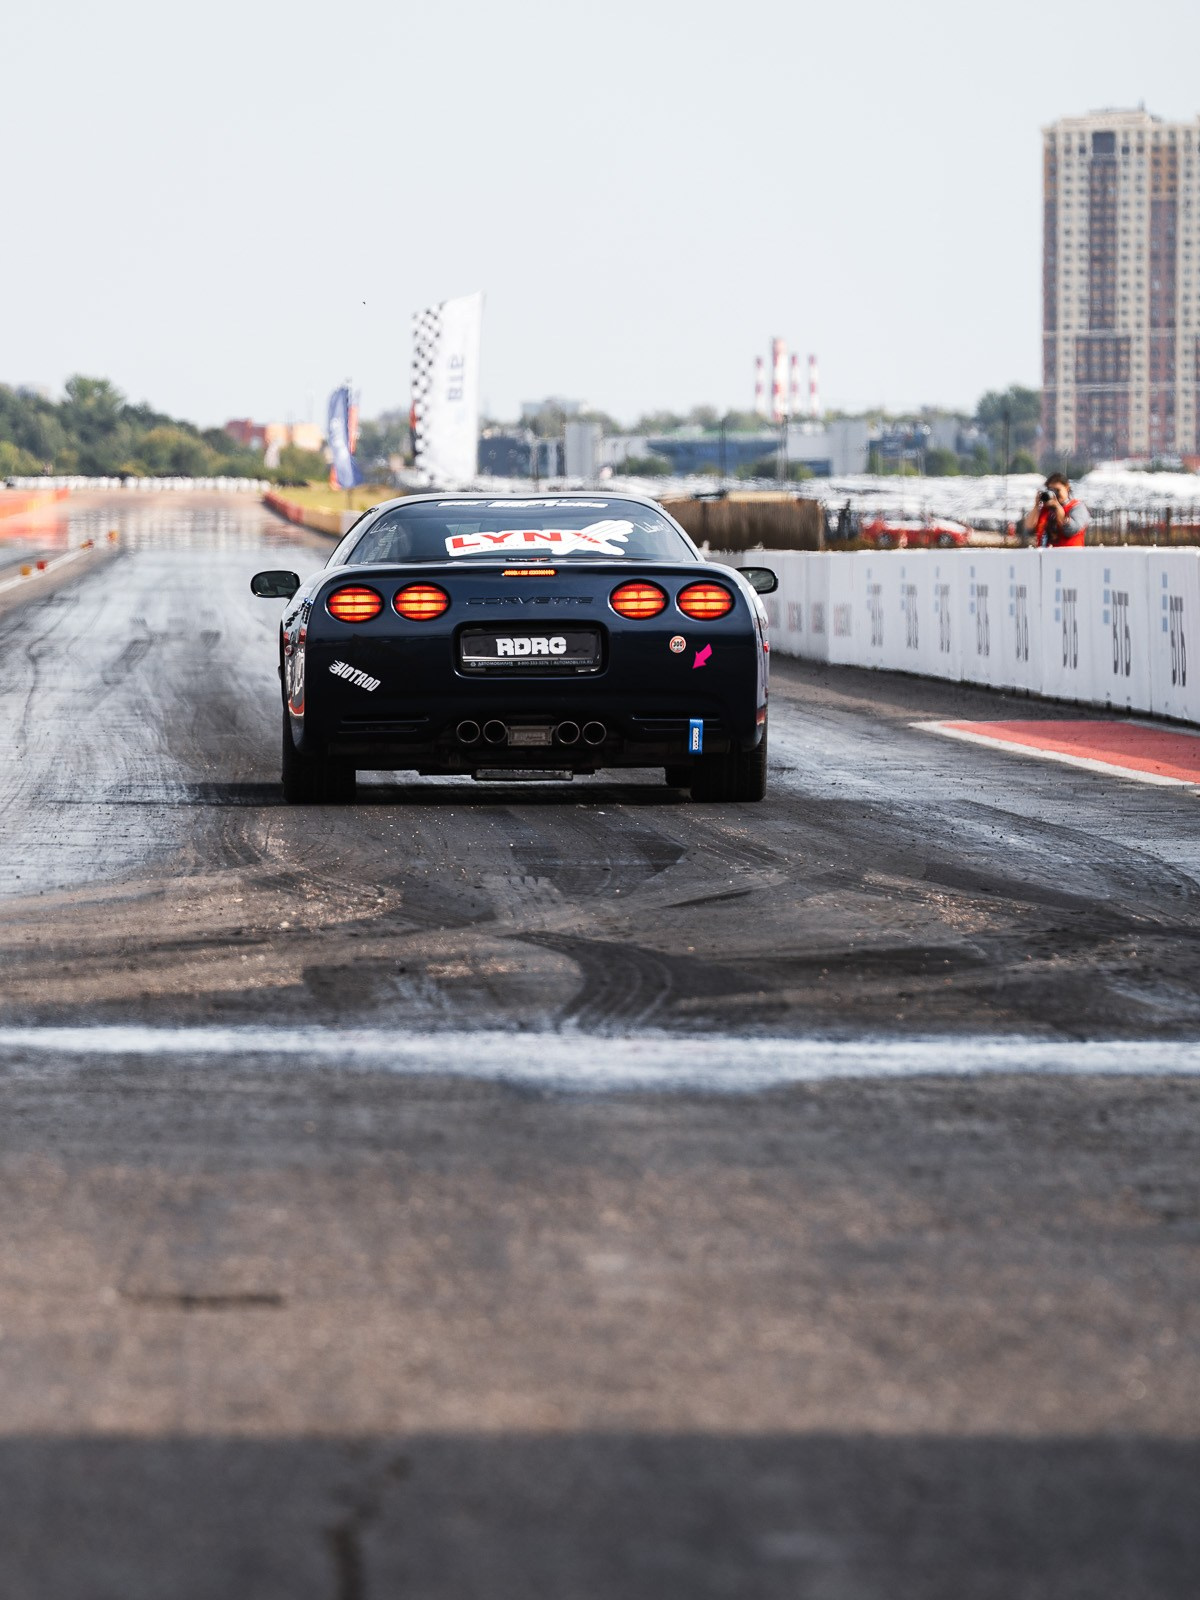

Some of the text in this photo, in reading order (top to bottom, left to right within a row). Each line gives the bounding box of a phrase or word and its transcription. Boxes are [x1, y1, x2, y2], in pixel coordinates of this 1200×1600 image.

[451, 531, 604, 549] LYNX
[495, 636, 567, 656] RDRC
[328, 659, 382, 692] HOTROD
